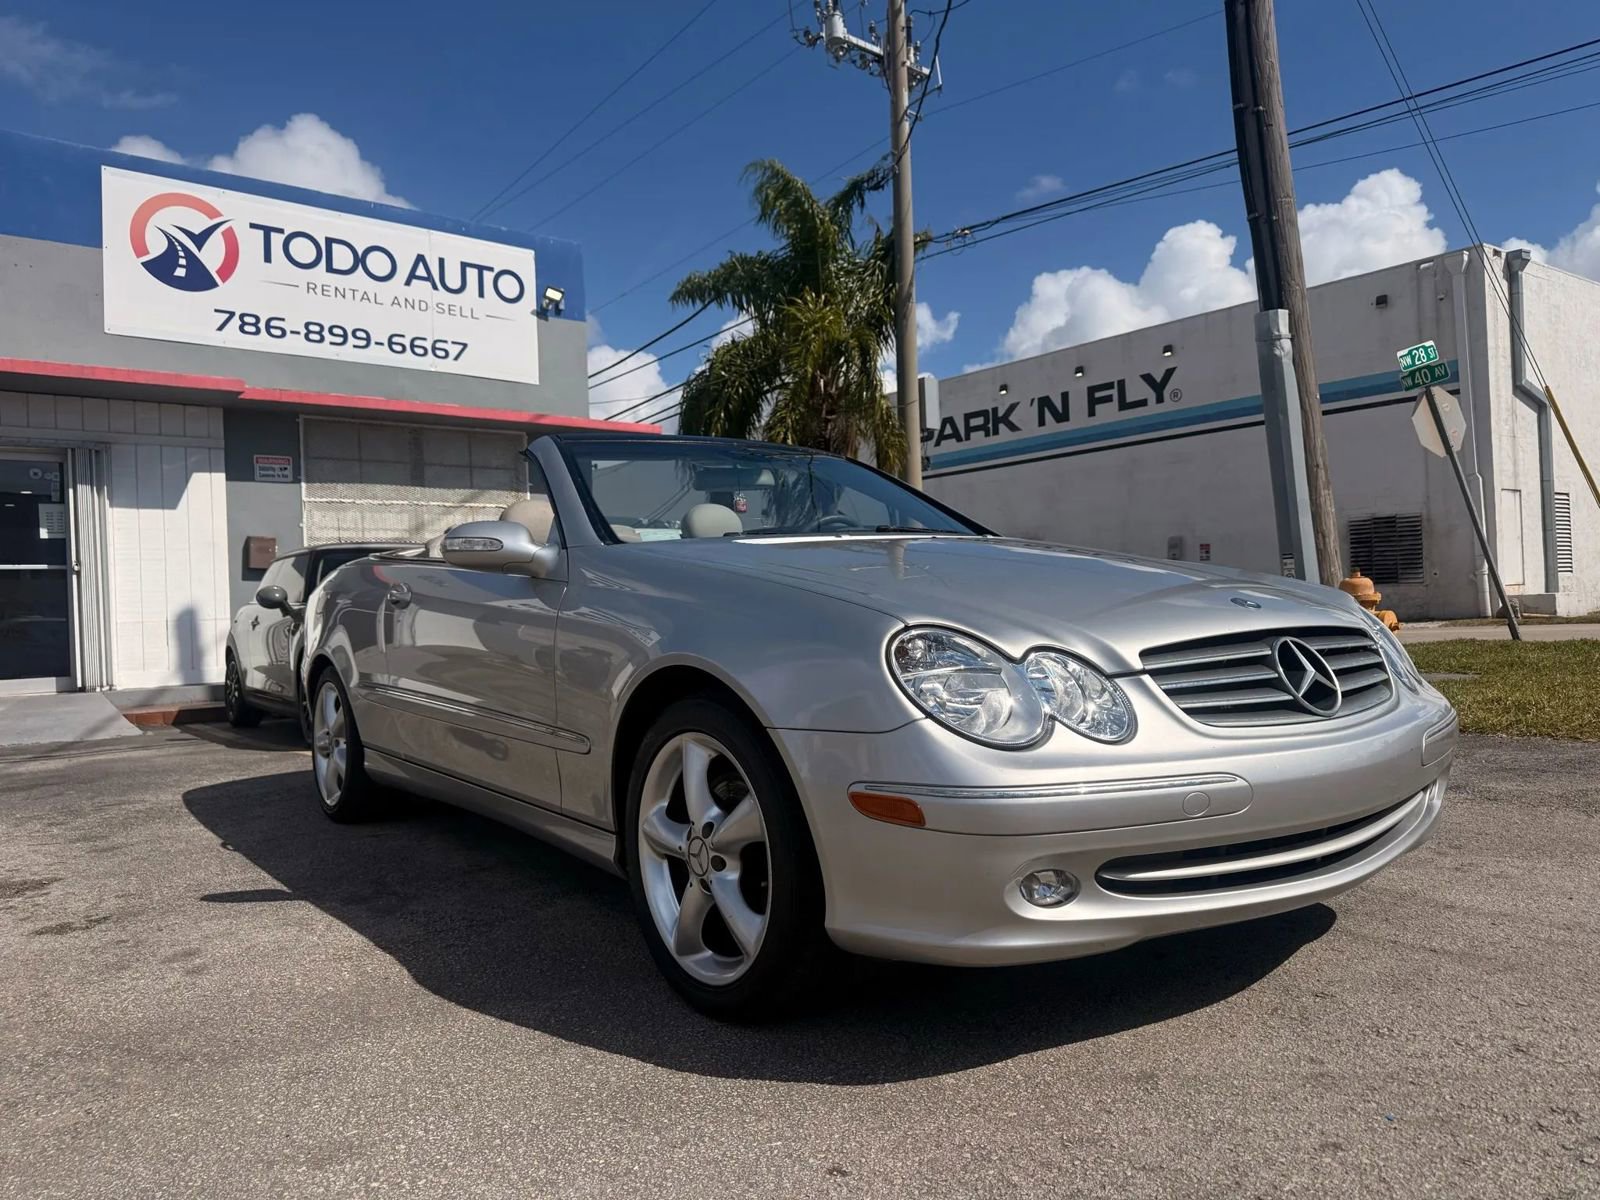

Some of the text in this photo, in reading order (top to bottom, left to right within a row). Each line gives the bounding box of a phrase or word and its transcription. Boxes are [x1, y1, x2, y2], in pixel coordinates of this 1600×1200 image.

[249, 221, 525, 304] TODO AUTO
[306, 282, 480, 320] RENTAL AND SELL
[213, 308, 469, 362] 786-899-6667
[1400, 347, 1436, 367] NW 28 ST
[1087, 366, 1178, 418] FLY
[1402, 364, 1445, 388] NW 40 AV
